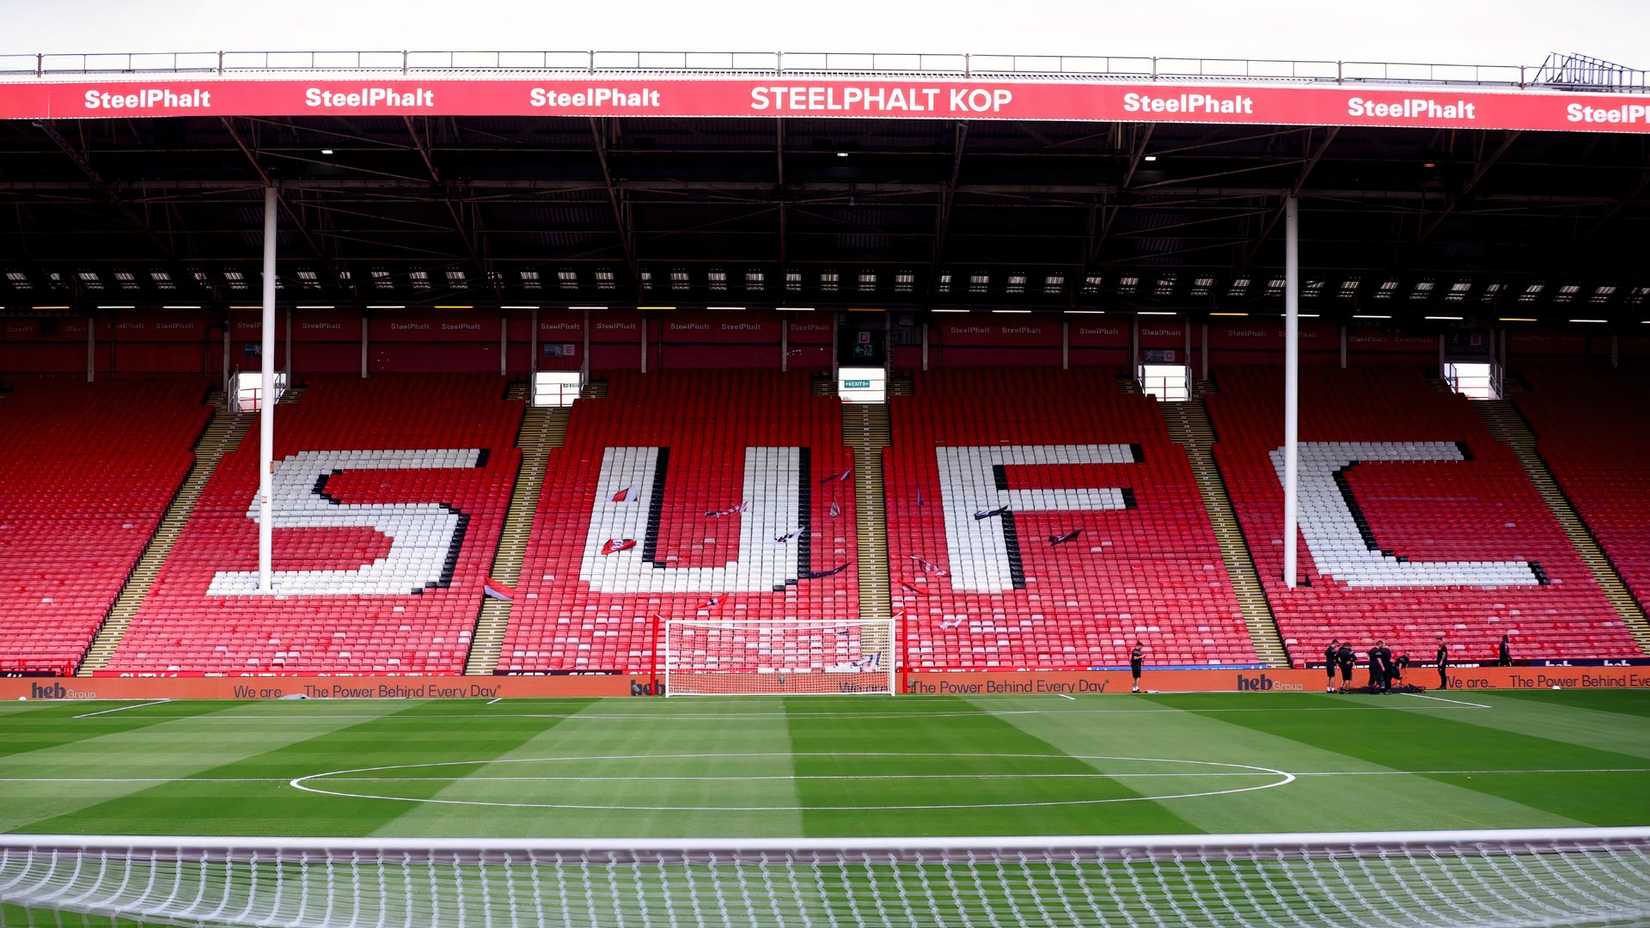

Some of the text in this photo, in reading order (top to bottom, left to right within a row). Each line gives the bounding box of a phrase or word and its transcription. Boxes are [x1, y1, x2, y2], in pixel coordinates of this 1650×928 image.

[84, 88, 211, 109] SteelPhalt
[305, 87, 434, 108] SteelPhalt
[530, 87, 660, 108] SteelPhalt
[750, 86, 1013, 112] STEELPHALT KOP
[1123, 92, 1253, 115] SteelPhalt
[1348, 97, 1476, 120] SteelPhalt
[234, 685, 256, 698] We
[304, 685, 329, 698] The
[333, 684, 374, 698] Power
[379, 684, 425, 697] Behind
[428, 684, 467, 697] Every
[940, 681, 983, 694] Power
[986, 680, 1033, 693] Behind
[1037, 679, 1075, 693] Every
[1510, 675, 1535, 688] The
[1537, 674, 1577, 688] Power
[1582, 674, 1626, 688] Behind
